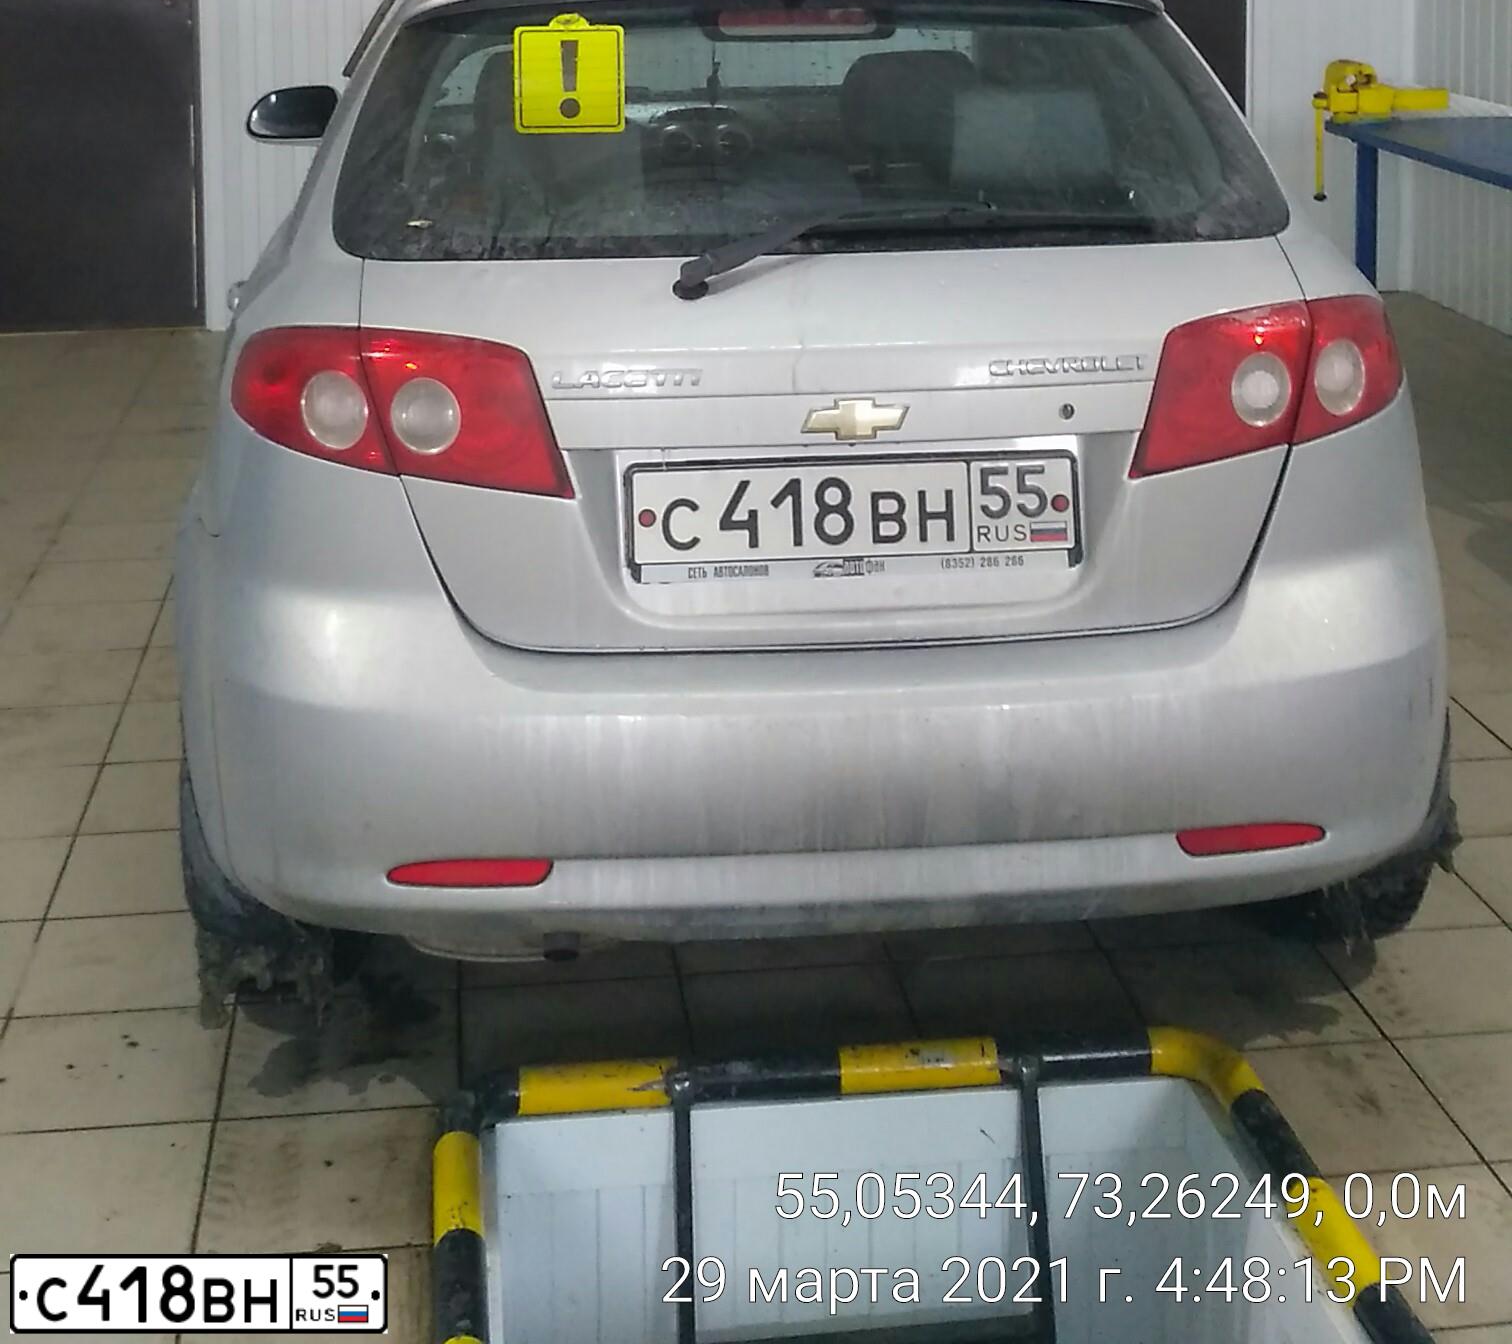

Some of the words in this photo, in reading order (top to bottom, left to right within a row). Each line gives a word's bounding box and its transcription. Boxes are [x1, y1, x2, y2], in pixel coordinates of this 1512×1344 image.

[988, 354, 1148, 377] CHEVROLET
[979, 465, 1048, 519] 55
[976, 523, 1027, 543] RUS
